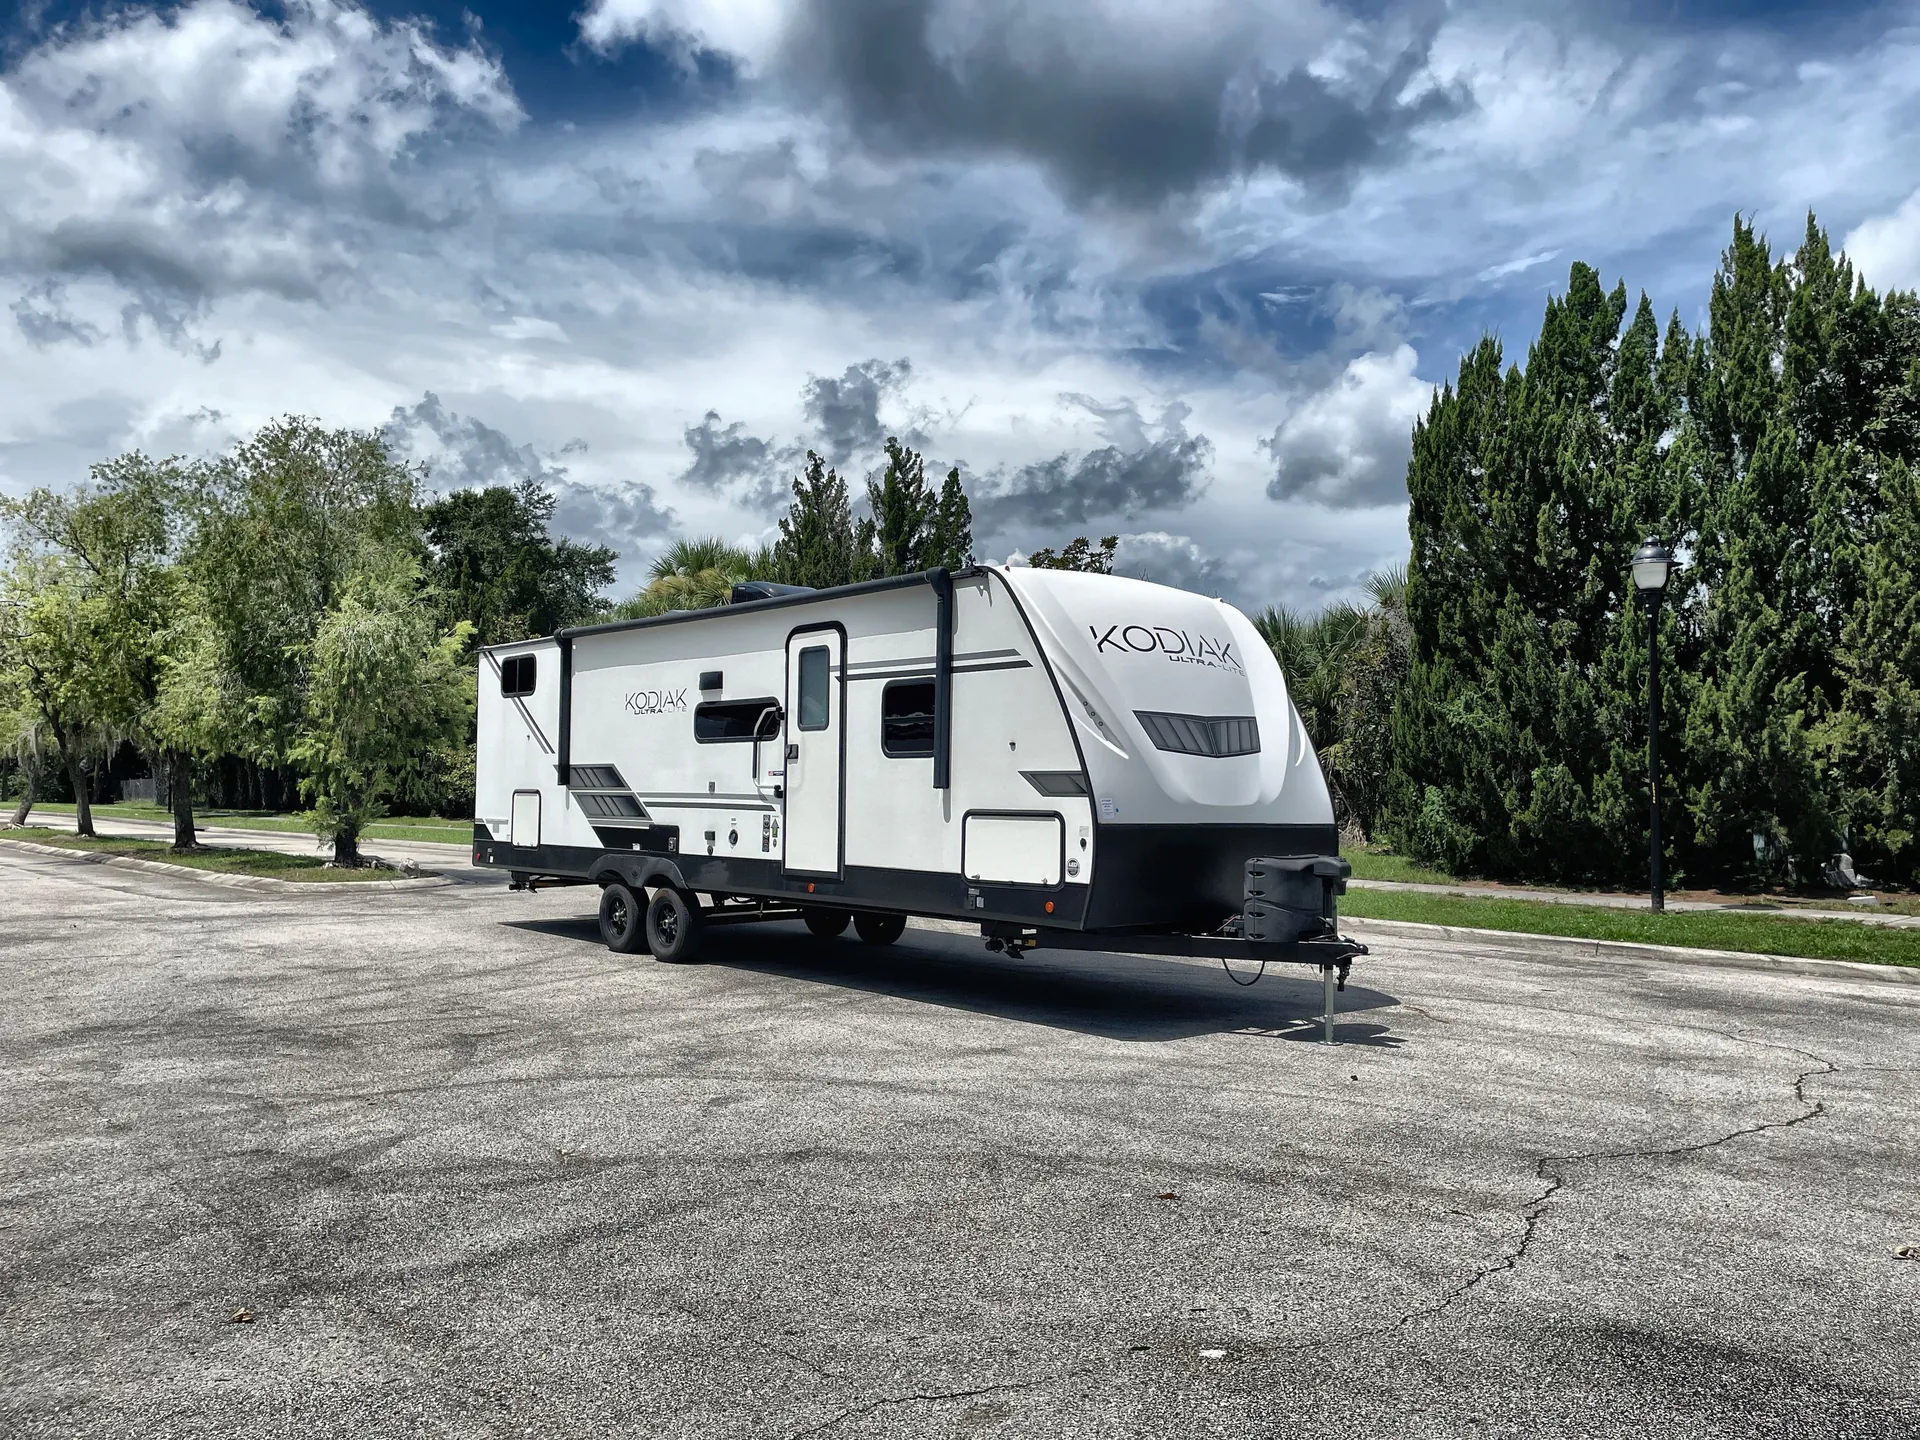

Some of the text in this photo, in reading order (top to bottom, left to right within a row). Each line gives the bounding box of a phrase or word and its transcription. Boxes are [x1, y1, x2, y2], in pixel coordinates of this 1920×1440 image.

[1089, 625, 1242, 668] KODIAK
[1169, 655, 1246, 677] ULTRA-LITE
[625, 688, 687, 710] KODIAK
[634, 706, 688, 715] ULTRA-LITE
